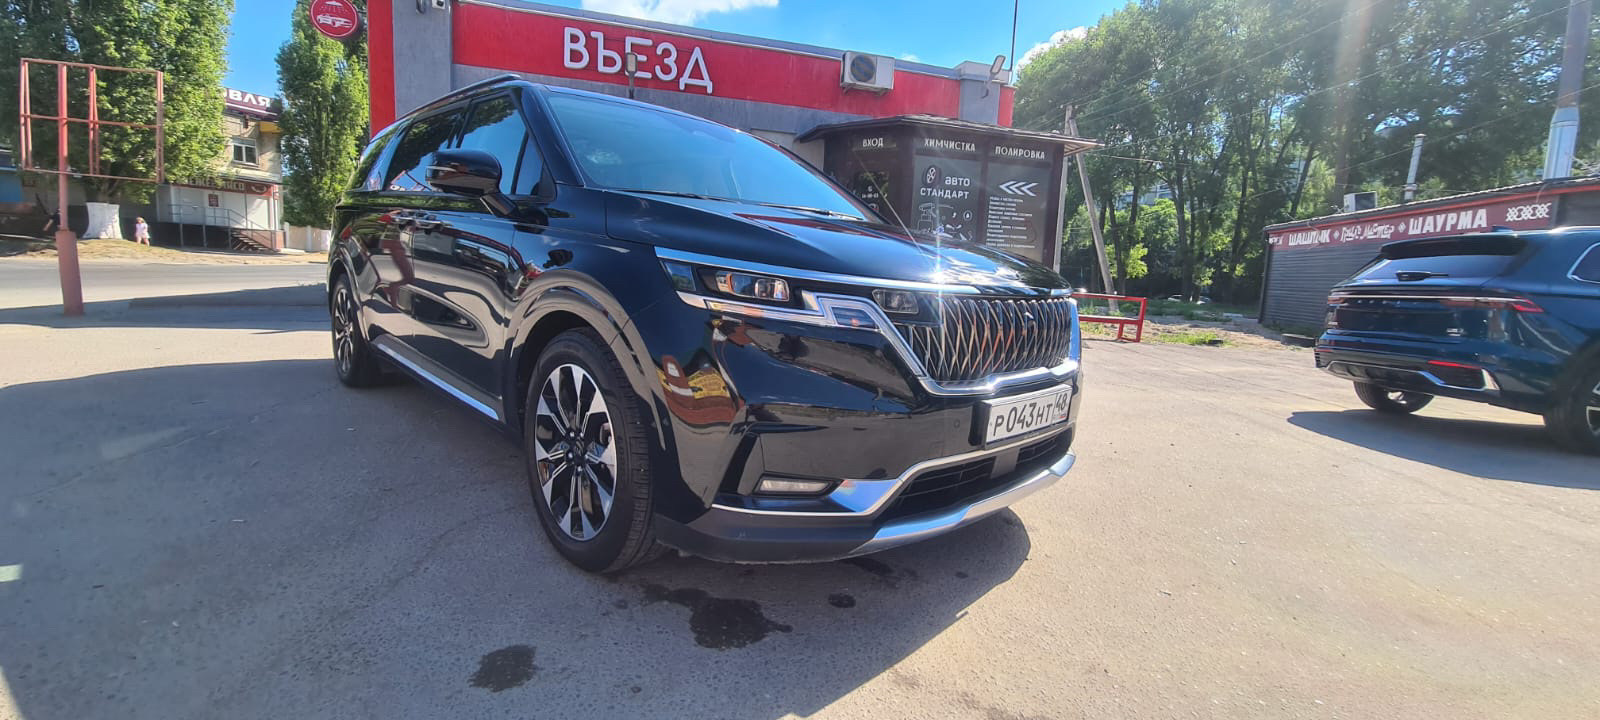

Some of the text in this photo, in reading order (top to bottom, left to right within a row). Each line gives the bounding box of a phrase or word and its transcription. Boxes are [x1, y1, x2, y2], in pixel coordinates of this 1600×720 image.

[563, 26, 713, 95] ВЪЕЗД
[862, 137, 884, 148] ВХОД
[924, 138, 976, 152] ХИМЧИСТКА
[995, 146, 1045, 160] ПОЛИРОВКА
[920, 187, 970, 200] СТАНДАРТ
[1408, 208, 1488, 235] ШАУРМА
[993, 392, 1068, 437] Р043НТ 48
